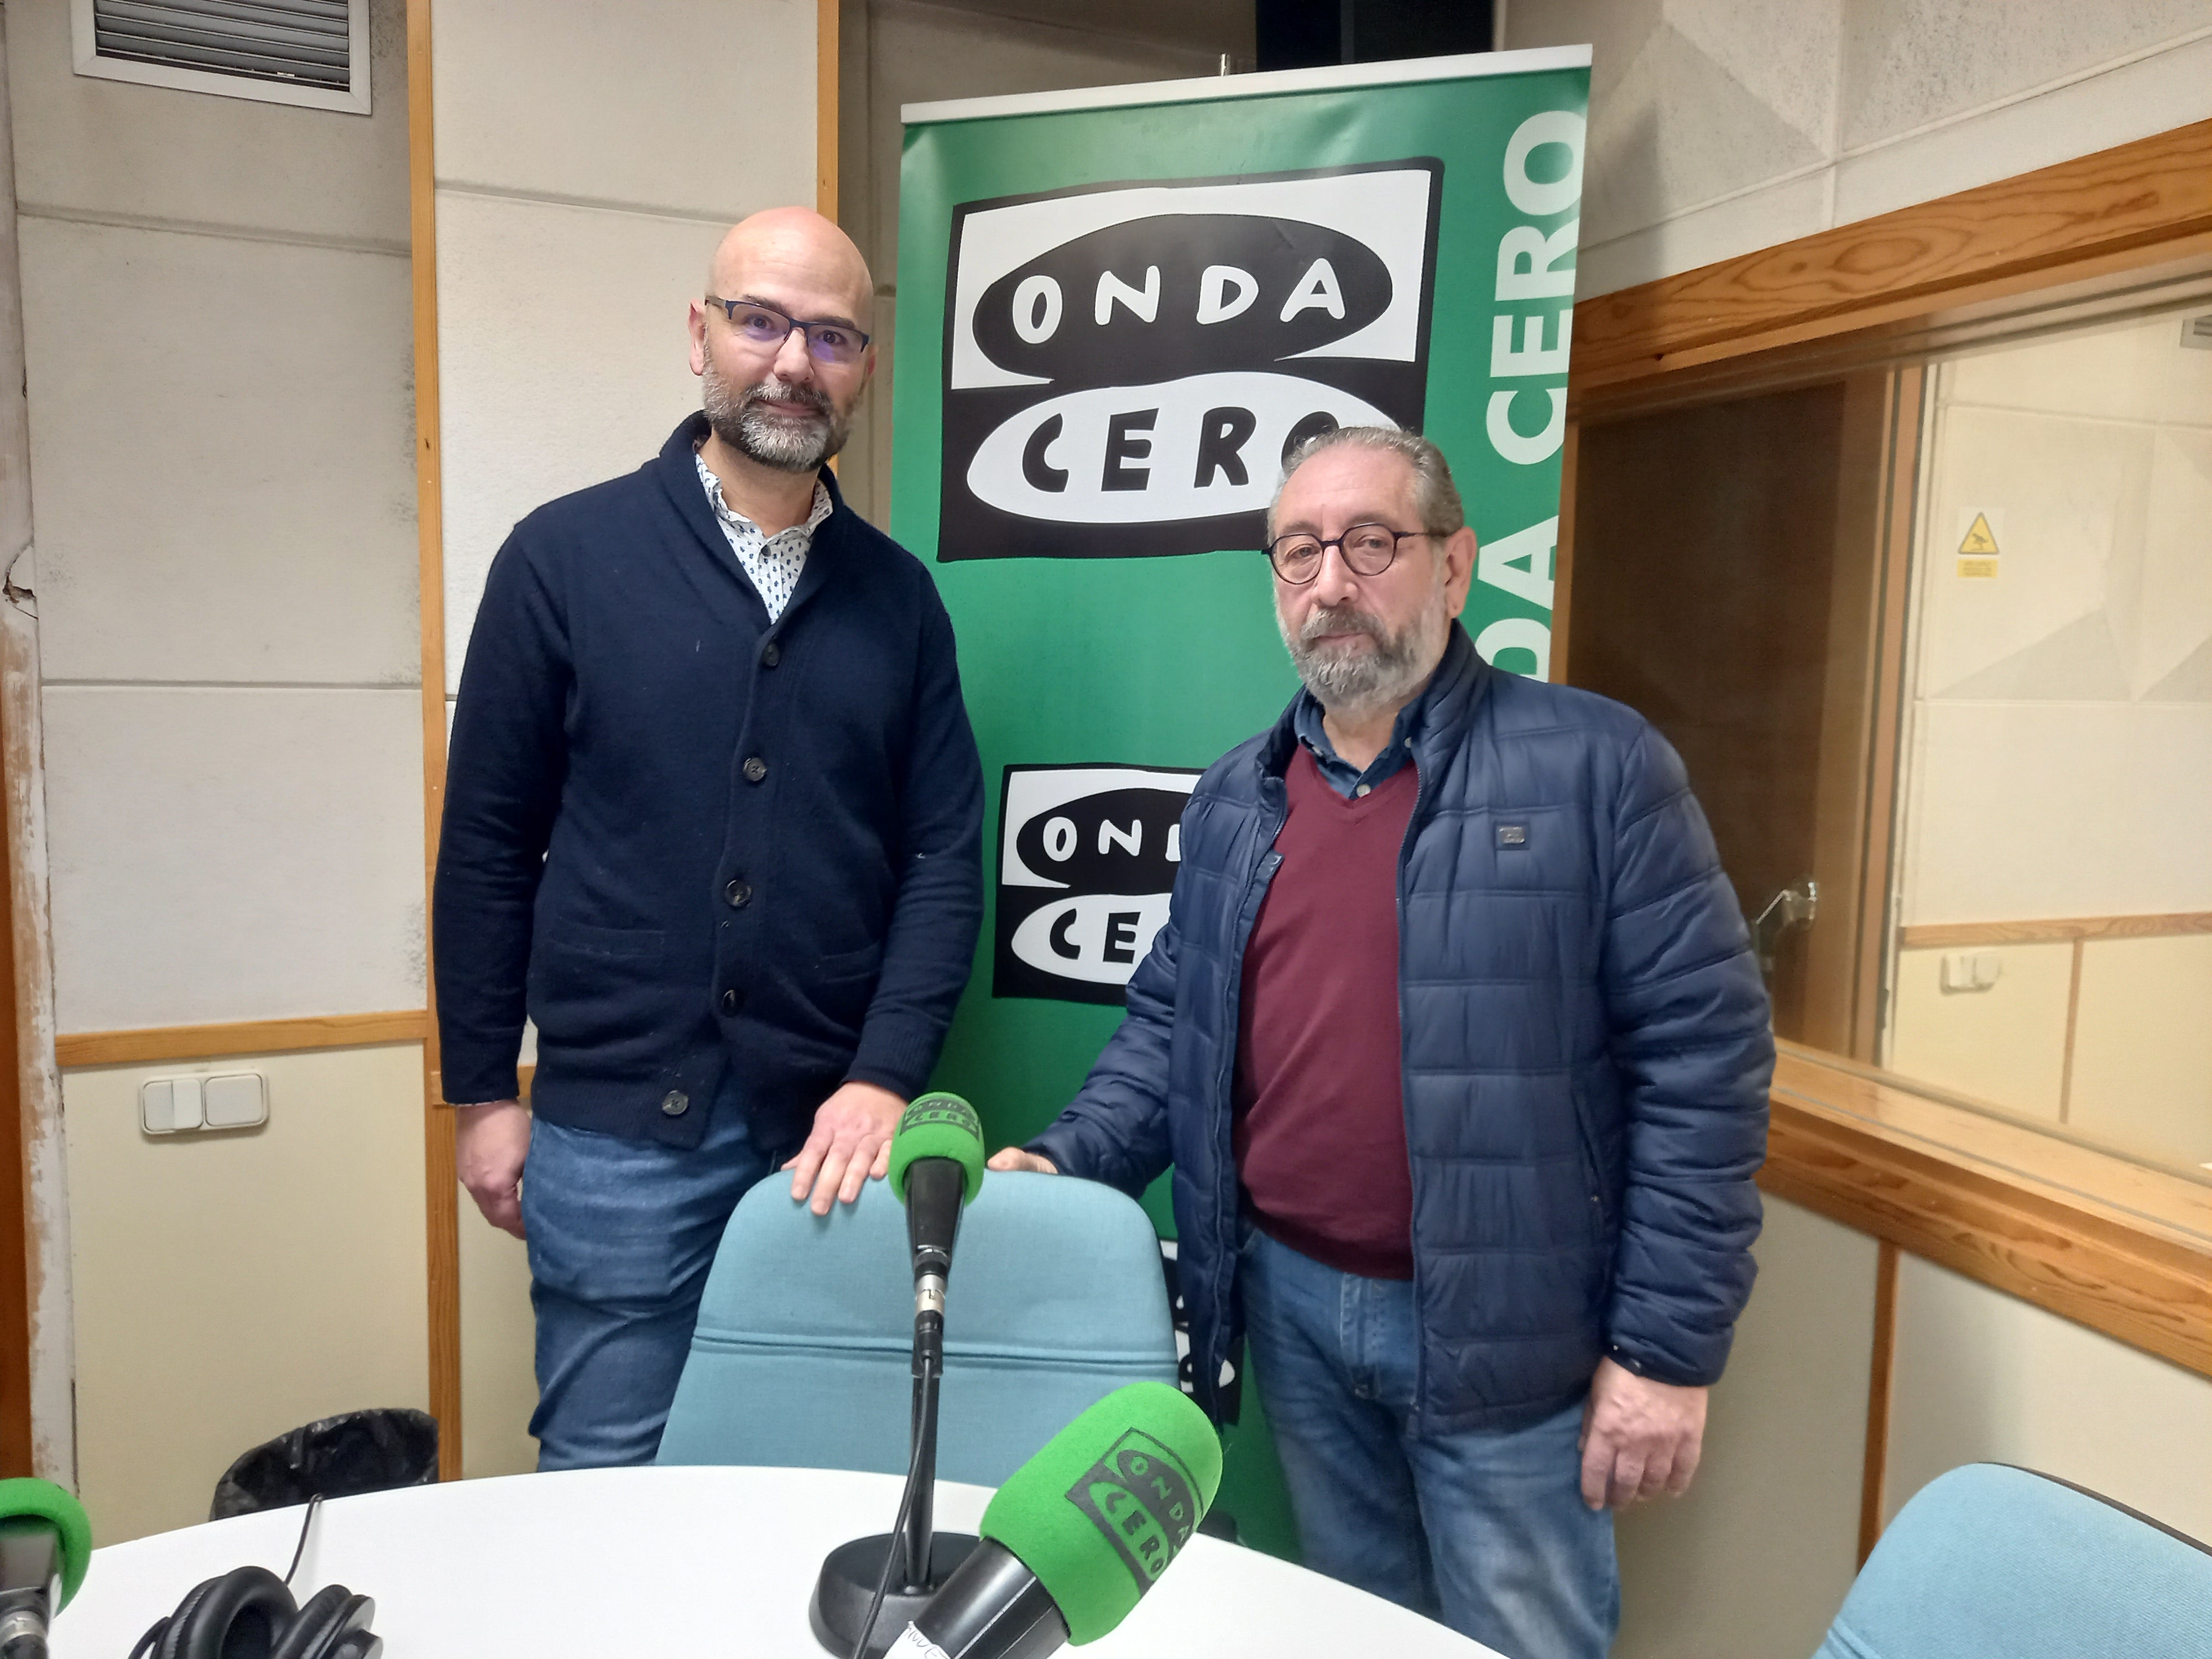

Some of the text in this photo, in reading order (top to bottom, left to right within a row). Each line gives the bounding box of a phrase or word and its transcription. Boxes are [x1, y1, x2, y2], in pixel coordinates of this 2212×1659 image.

[1011, 258, 1346, 345] ONDA
[1485, 109, 1587, 465] CERO
[1043, 816, 1181, 862] ON
[1050, 908, 1141, 964] CE
[1105, 1491, 1165, 1574] CERO
